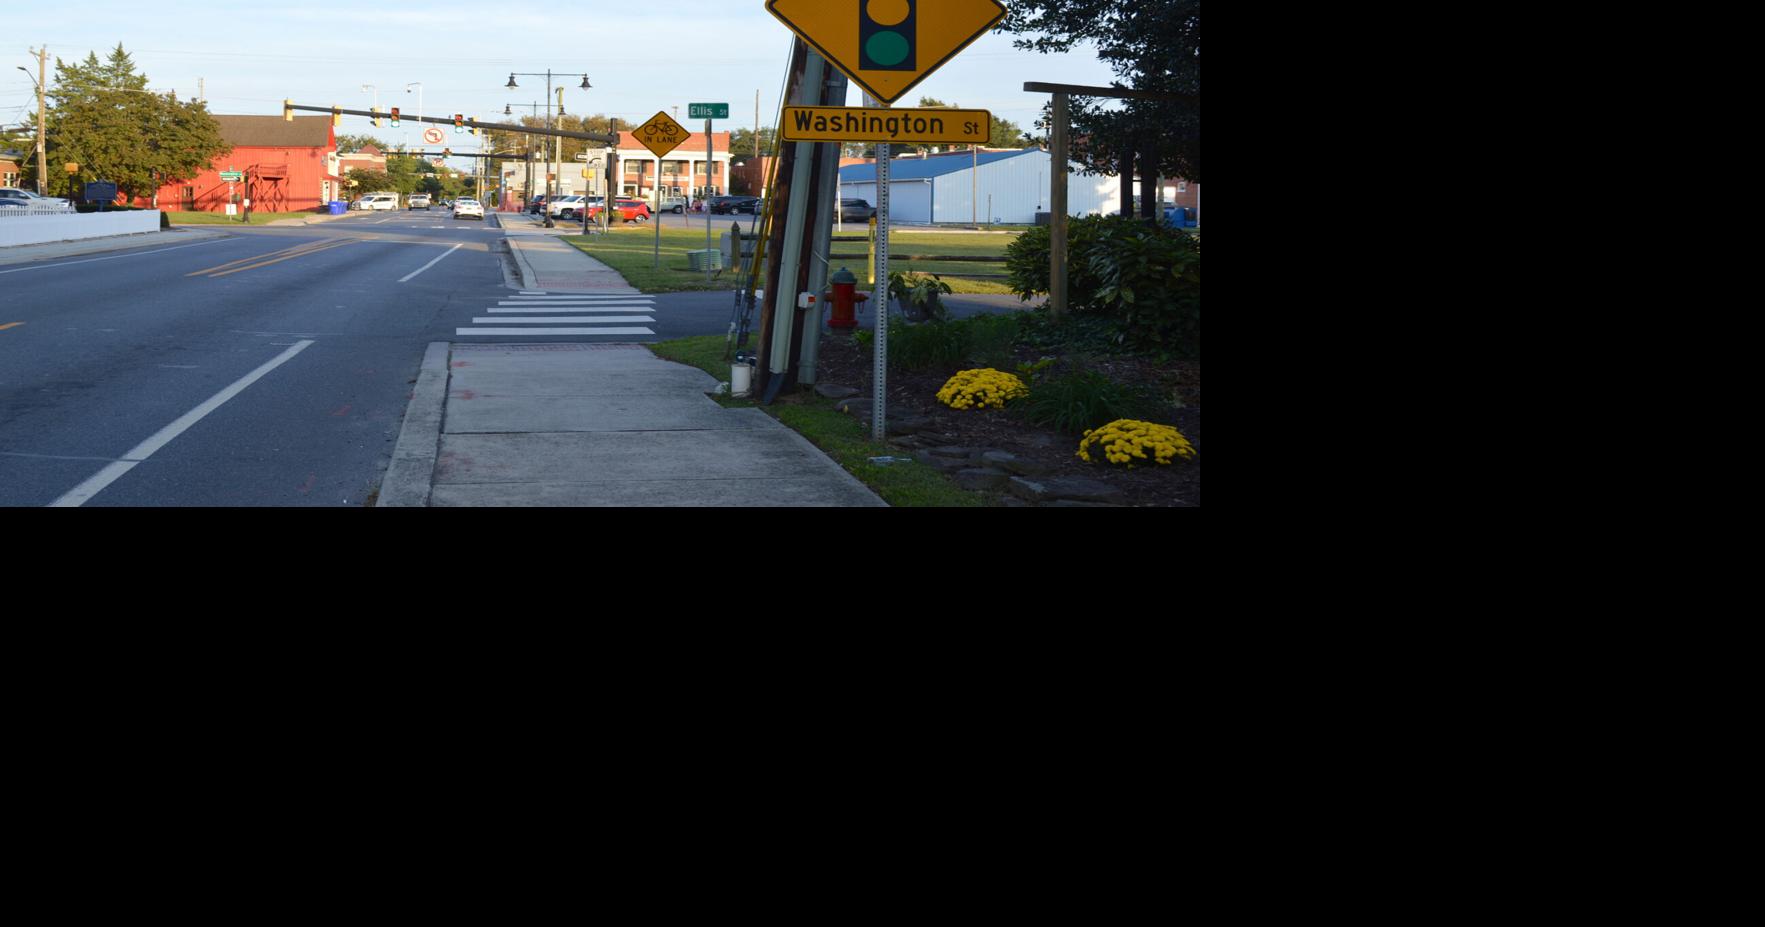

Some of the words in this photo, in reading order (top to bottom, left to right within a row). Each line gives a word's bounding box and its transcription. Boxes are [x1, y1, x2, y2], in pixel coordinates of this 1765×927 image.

[690, 106, 713, 116] Ellis
[793, 110, 944, 138] Washington
[963, 121, 980, 135] St
[644, 136, 652, 144] IN
[656, 136, 678, 144] LANE
